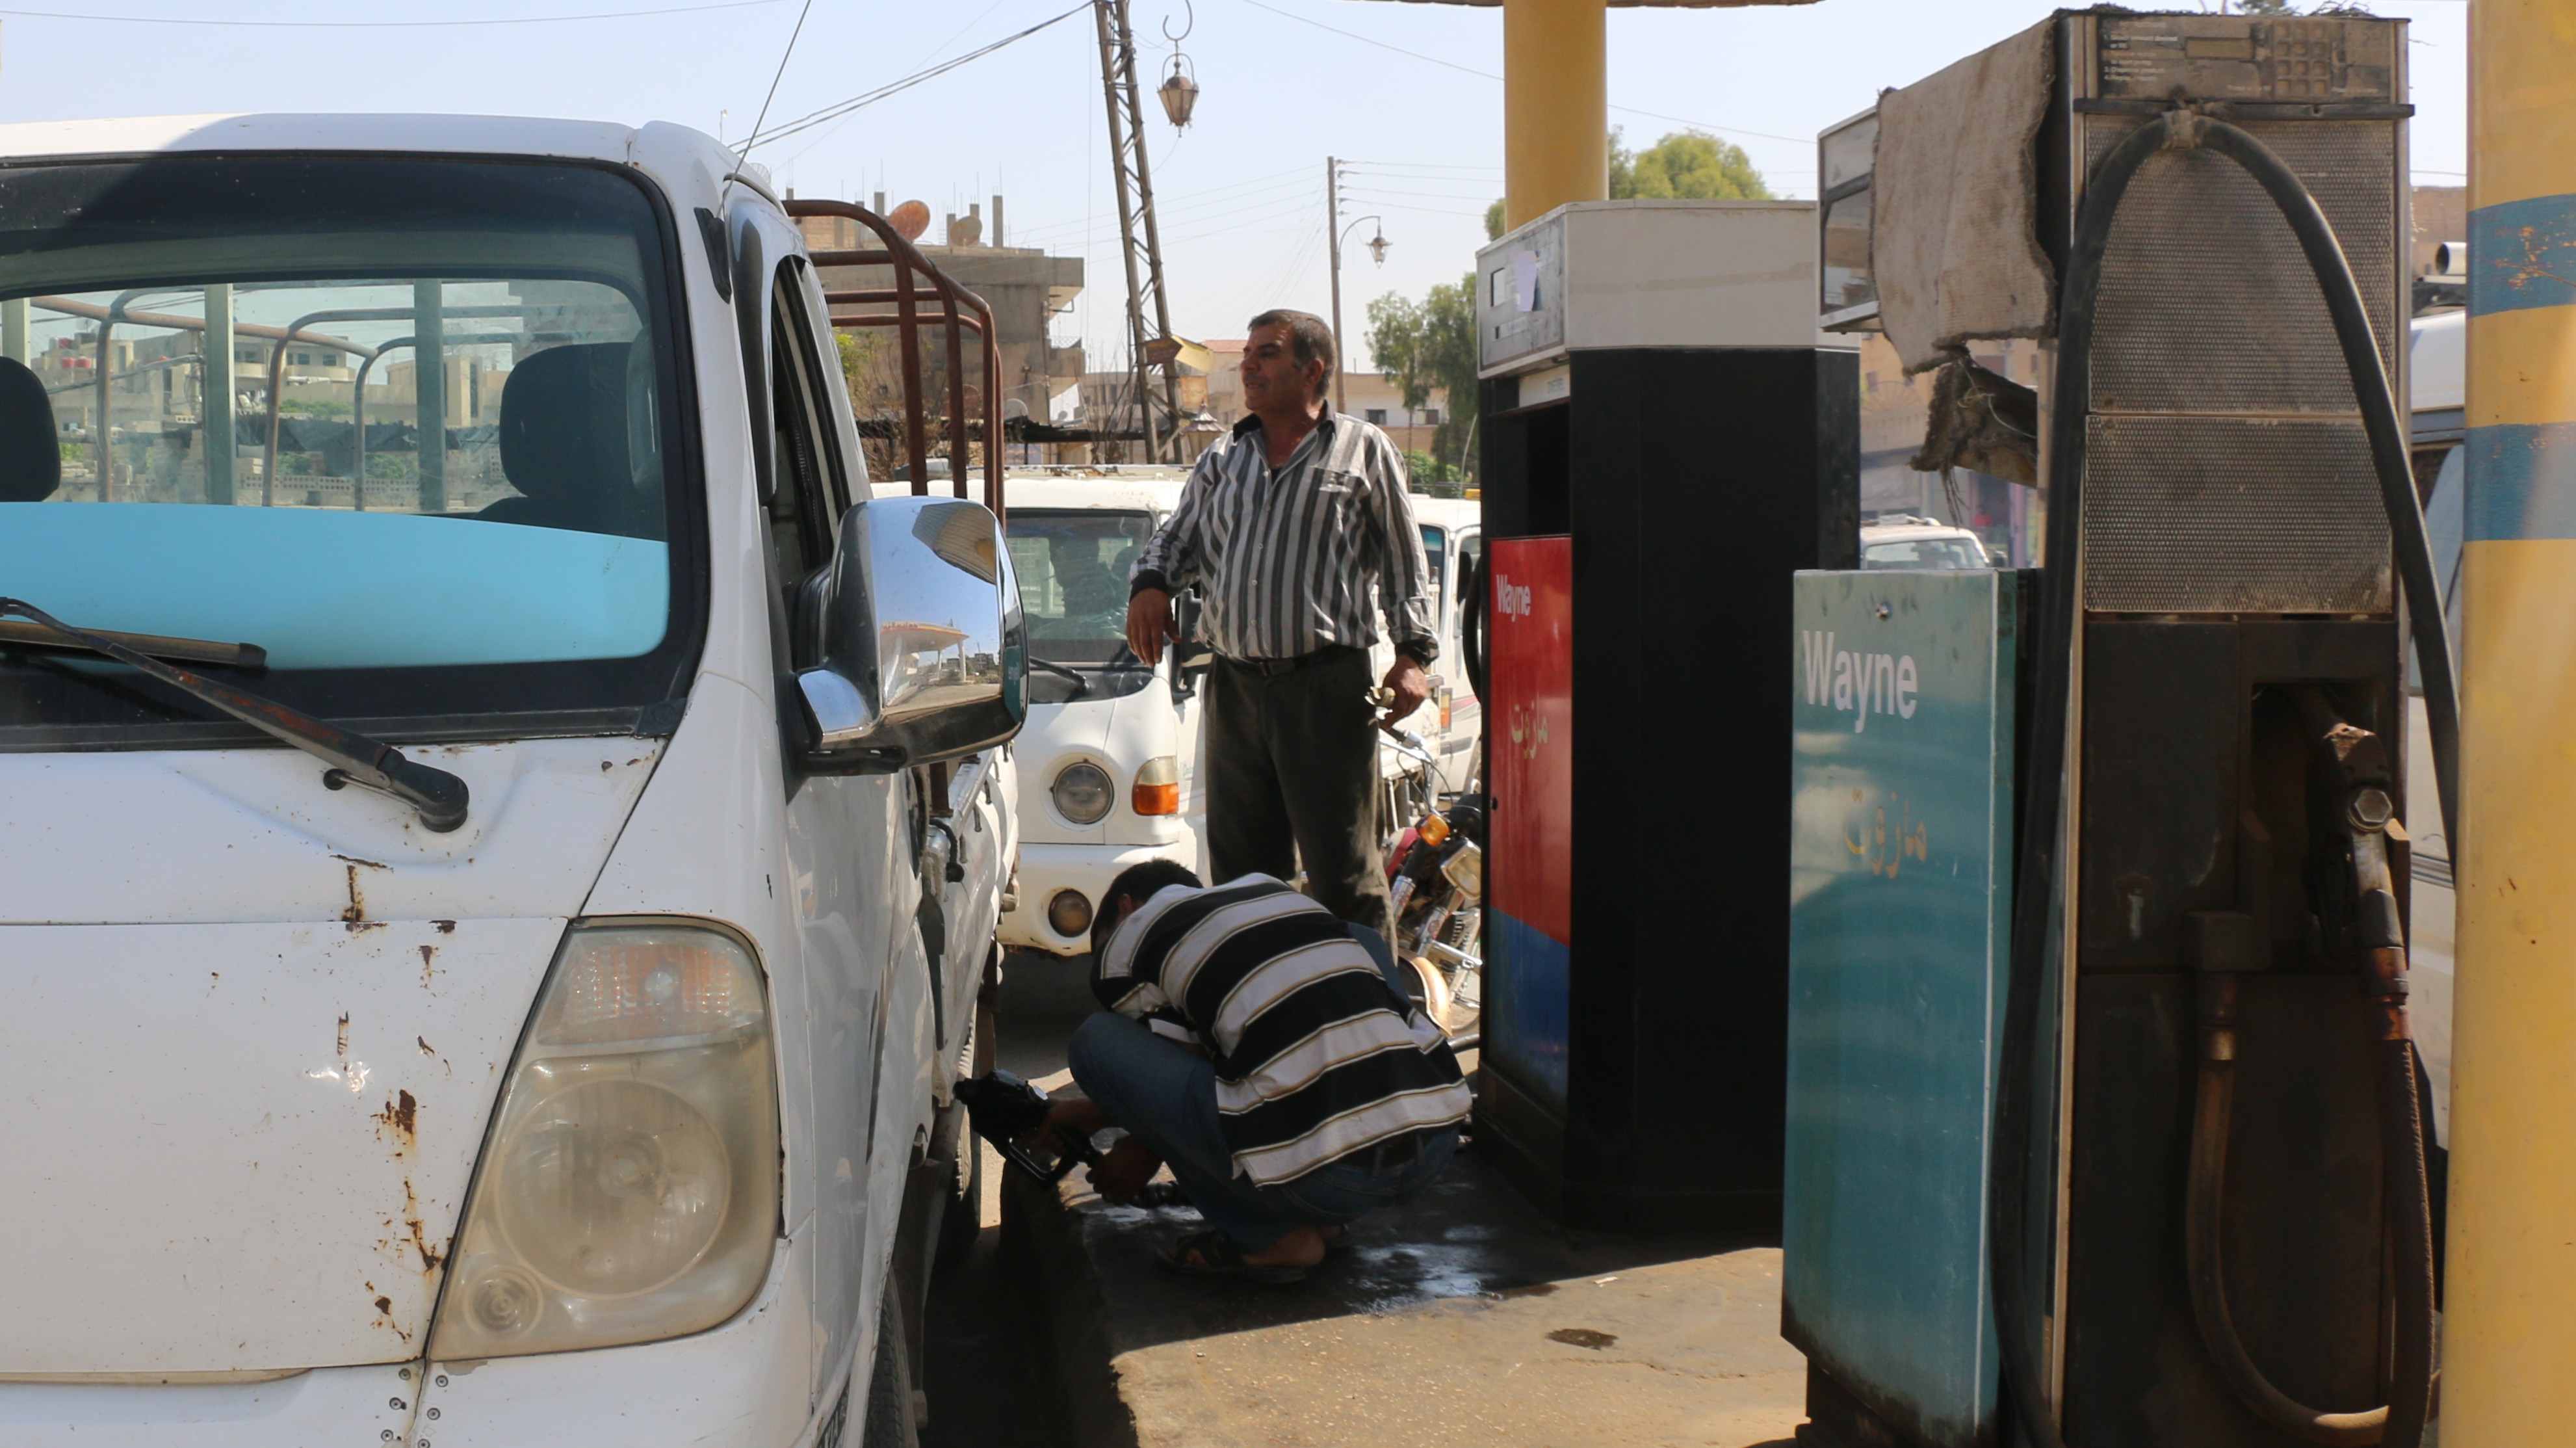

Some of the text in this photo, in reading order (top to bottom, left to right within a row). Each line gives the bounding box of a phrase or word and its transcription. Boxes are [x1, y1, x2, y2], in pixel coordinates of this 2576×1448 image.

[1496, 574, 1531, 622] Wayne
[1803, 629, 1918, 733] Wayne
[1511, 693, 1548, 759] مازوت
[1843, 787, 1927, 879] مازوت
